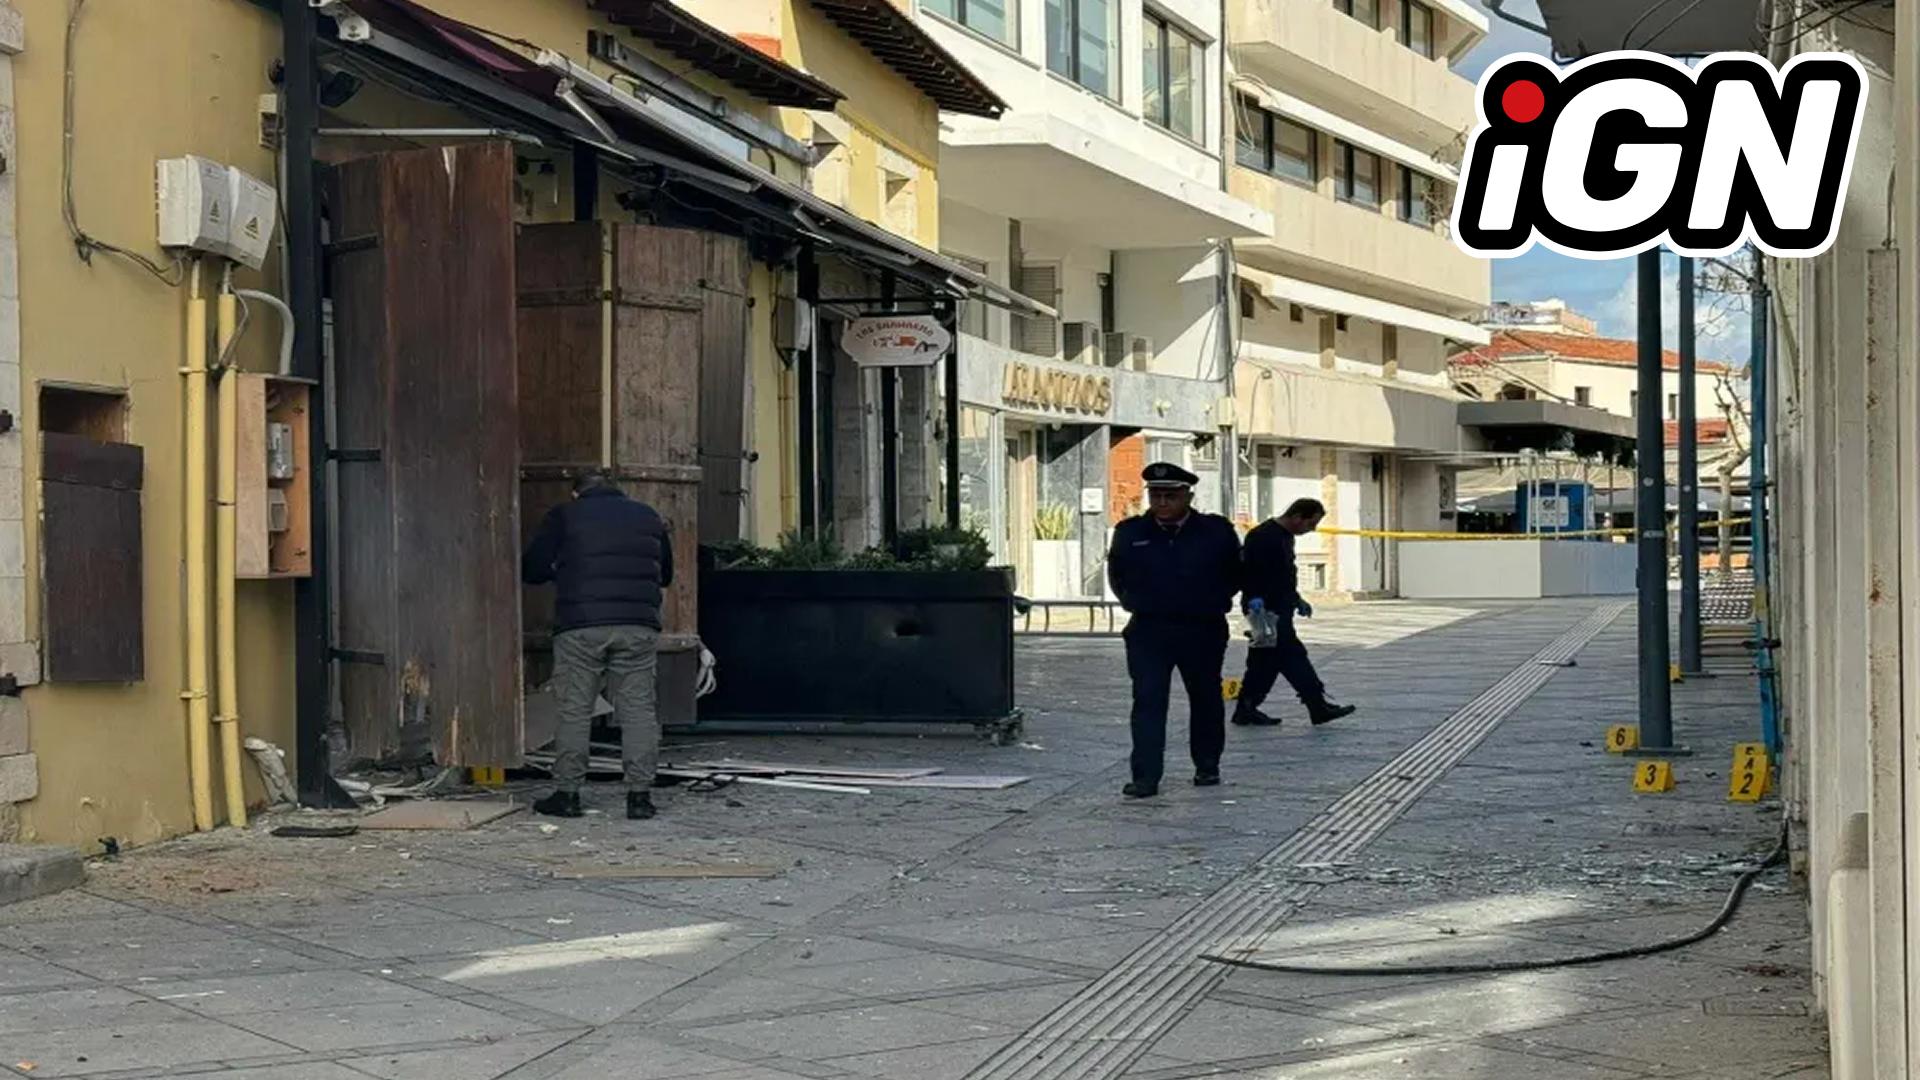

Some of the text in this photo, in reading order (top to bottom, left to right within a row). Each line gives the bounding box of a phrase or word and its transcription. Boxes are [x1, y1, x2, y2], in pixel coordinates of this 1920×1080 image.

[1615, 727, 1626, 746] 6
[1644, 764, 1657, 785] 3
[1739, 772, 1754, 794] 2
